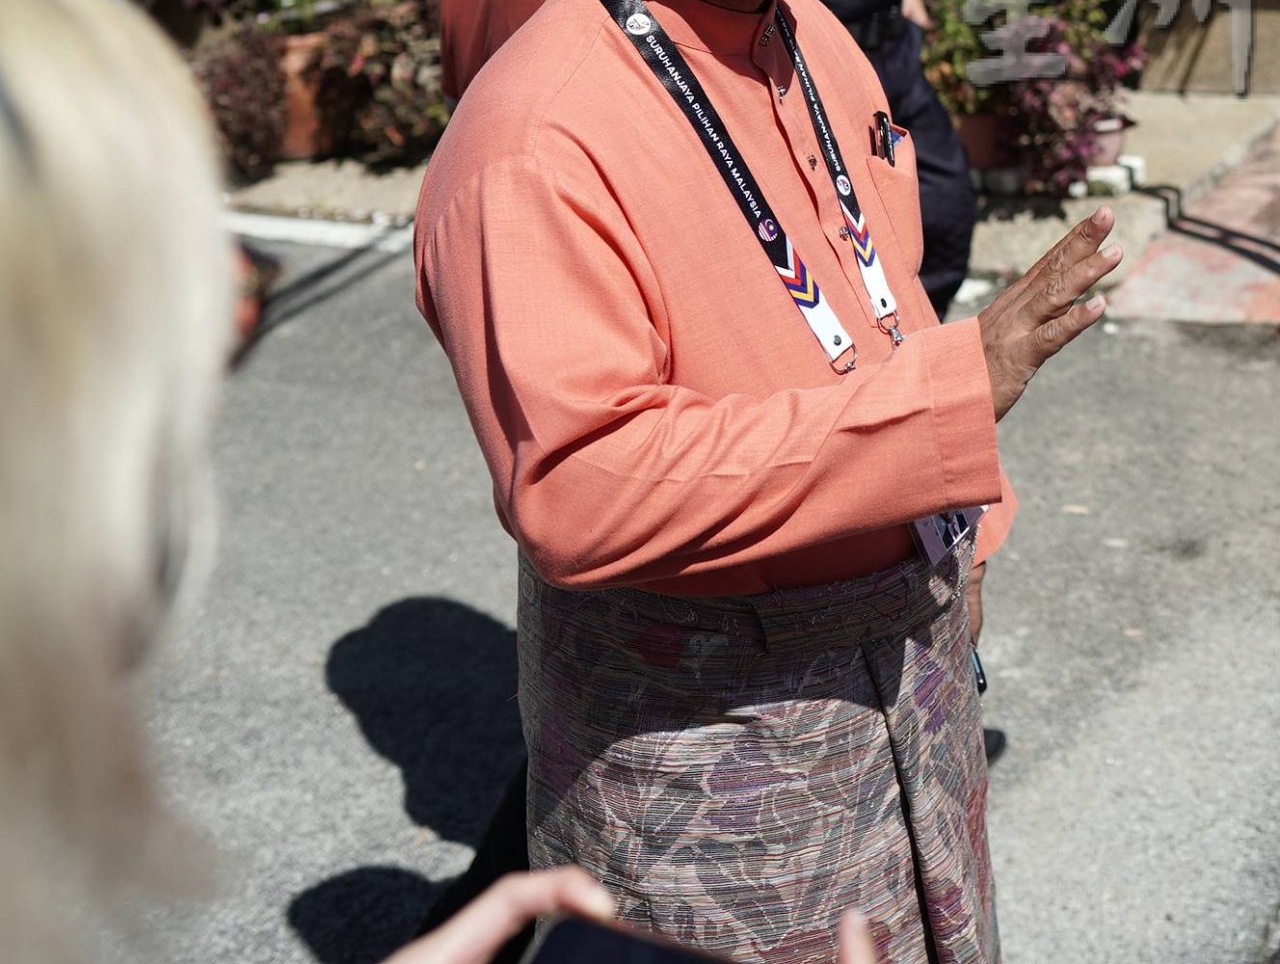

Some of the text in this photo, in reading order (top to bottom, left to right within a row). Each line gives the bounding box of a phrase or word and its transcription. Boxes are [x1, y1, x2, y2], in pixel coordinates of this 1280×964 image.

[797, 63, 815, 102] PILIHAN
[646, 35, 762, 219] SURUHANJAYA PILIHAN RAYA MALAYSIA
[813, 103, 841, 172] SURUHANJAYA
